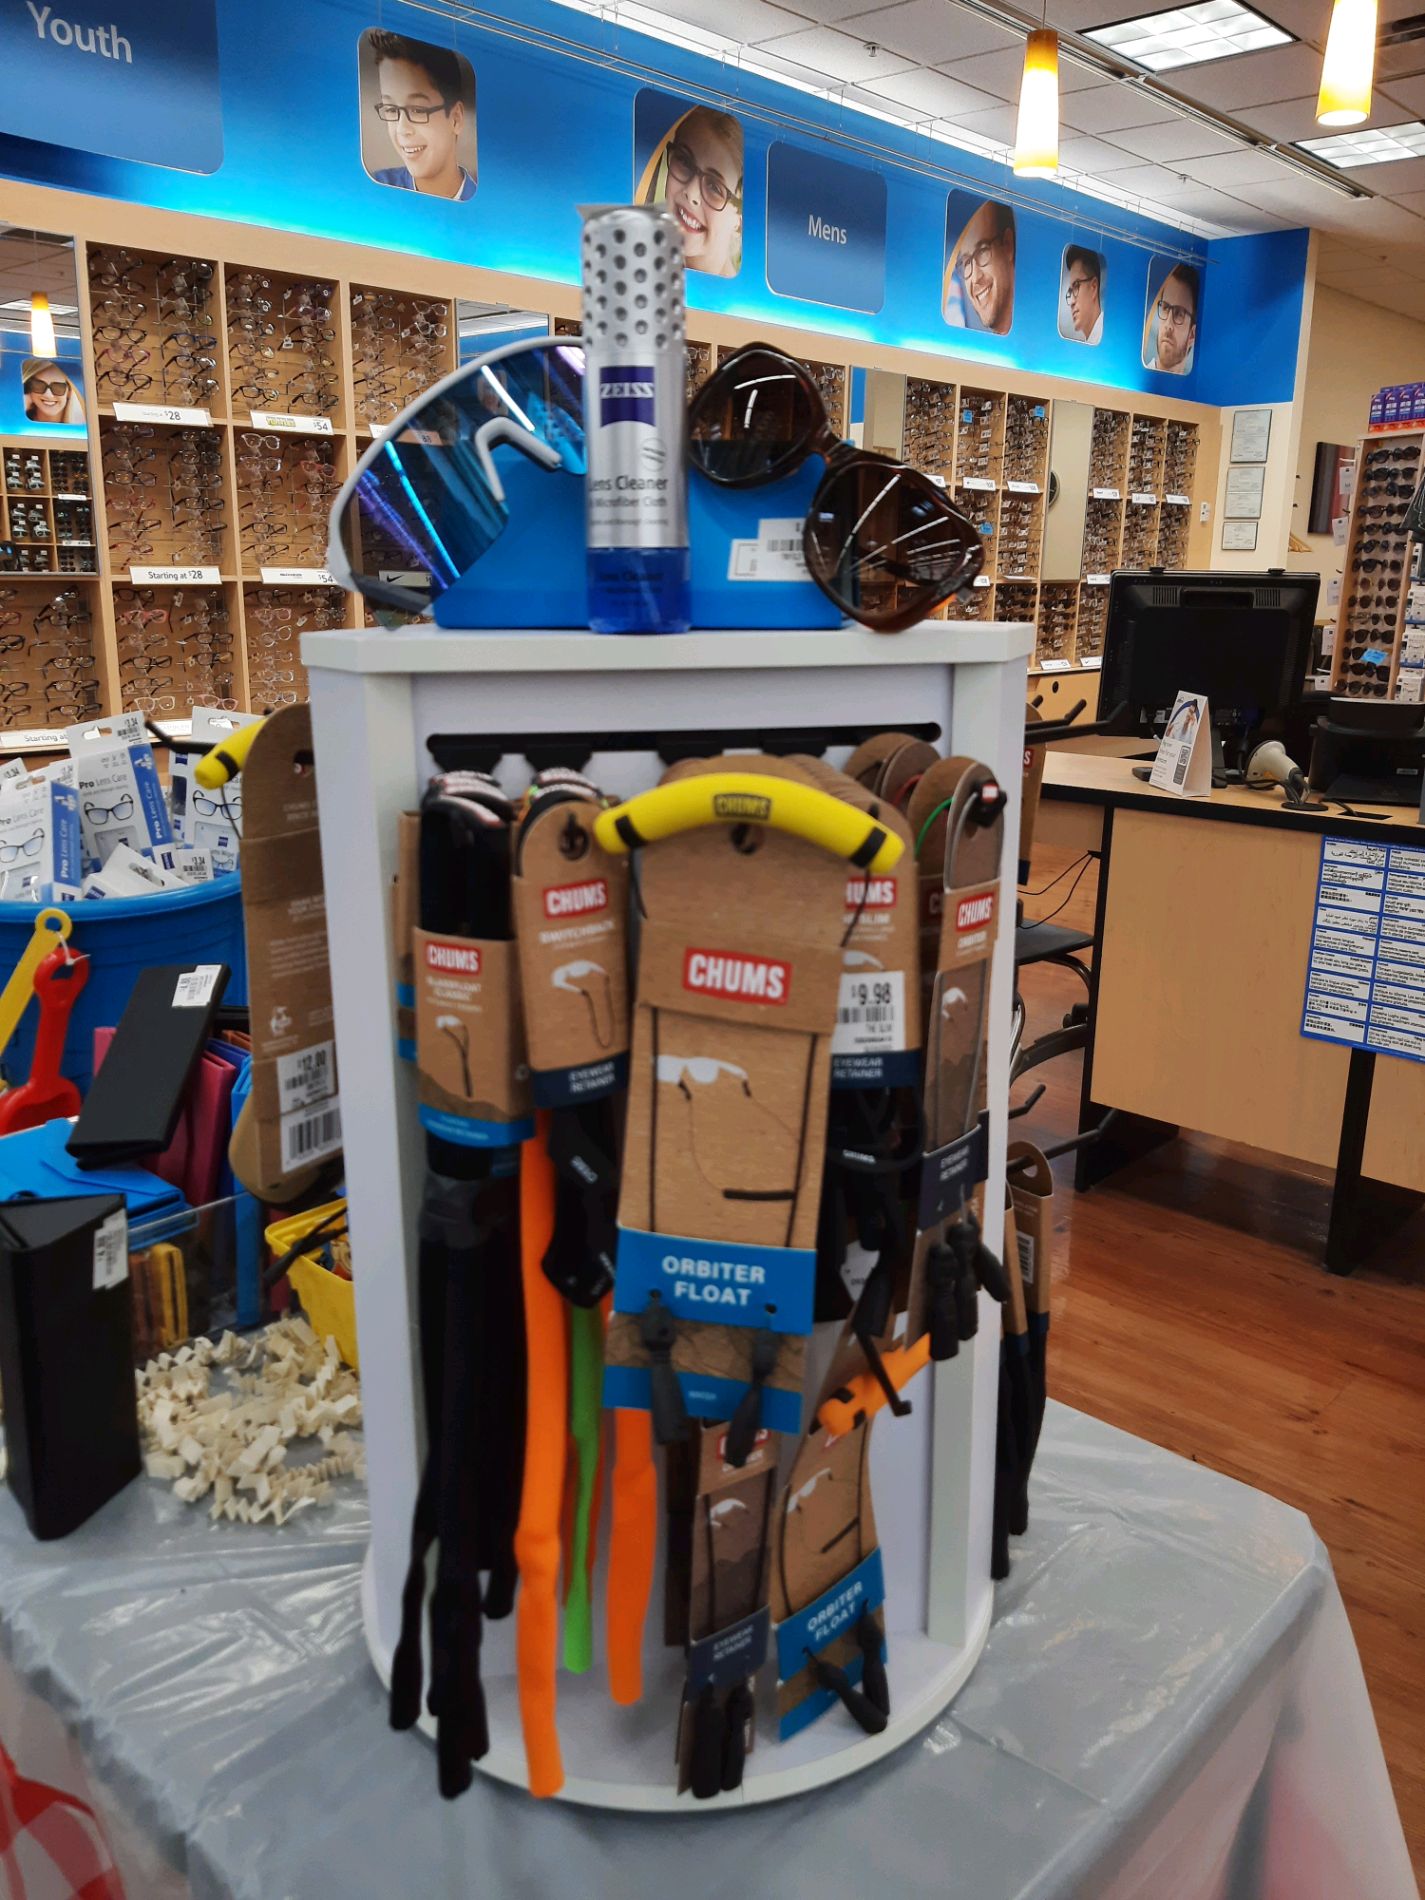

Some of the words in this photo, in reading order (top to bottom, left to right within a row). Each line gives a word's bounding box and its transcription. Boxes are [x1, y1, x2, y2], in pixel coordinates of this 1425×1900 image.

[25, 0, 133, 64] Youth
[807, 213, 848, 245] Mens
[600, 382, 655, 400] ZEISS
[615, 474, 668, 491] Cleaner
[148, 571, 179, 581] Starting
[180, 572, 187, 580] at
[24, 734, 58, 742] Starting
[79, 781, 95, 790] Pro
[546, 881, 607, 916] CHUMS
[957, 897, 993, 928] CHUMS
[427, 944, 479, 972] CHUMS
[688, 953, 785, 998] CHUMS
[662, 1255, 765, 1284] ORBITER
[674, 1280, 752, 1306] FLOAT
[806, 1581, 863, 1632] ORBITER
[814, 1601, 856, 1641] FLOAT
